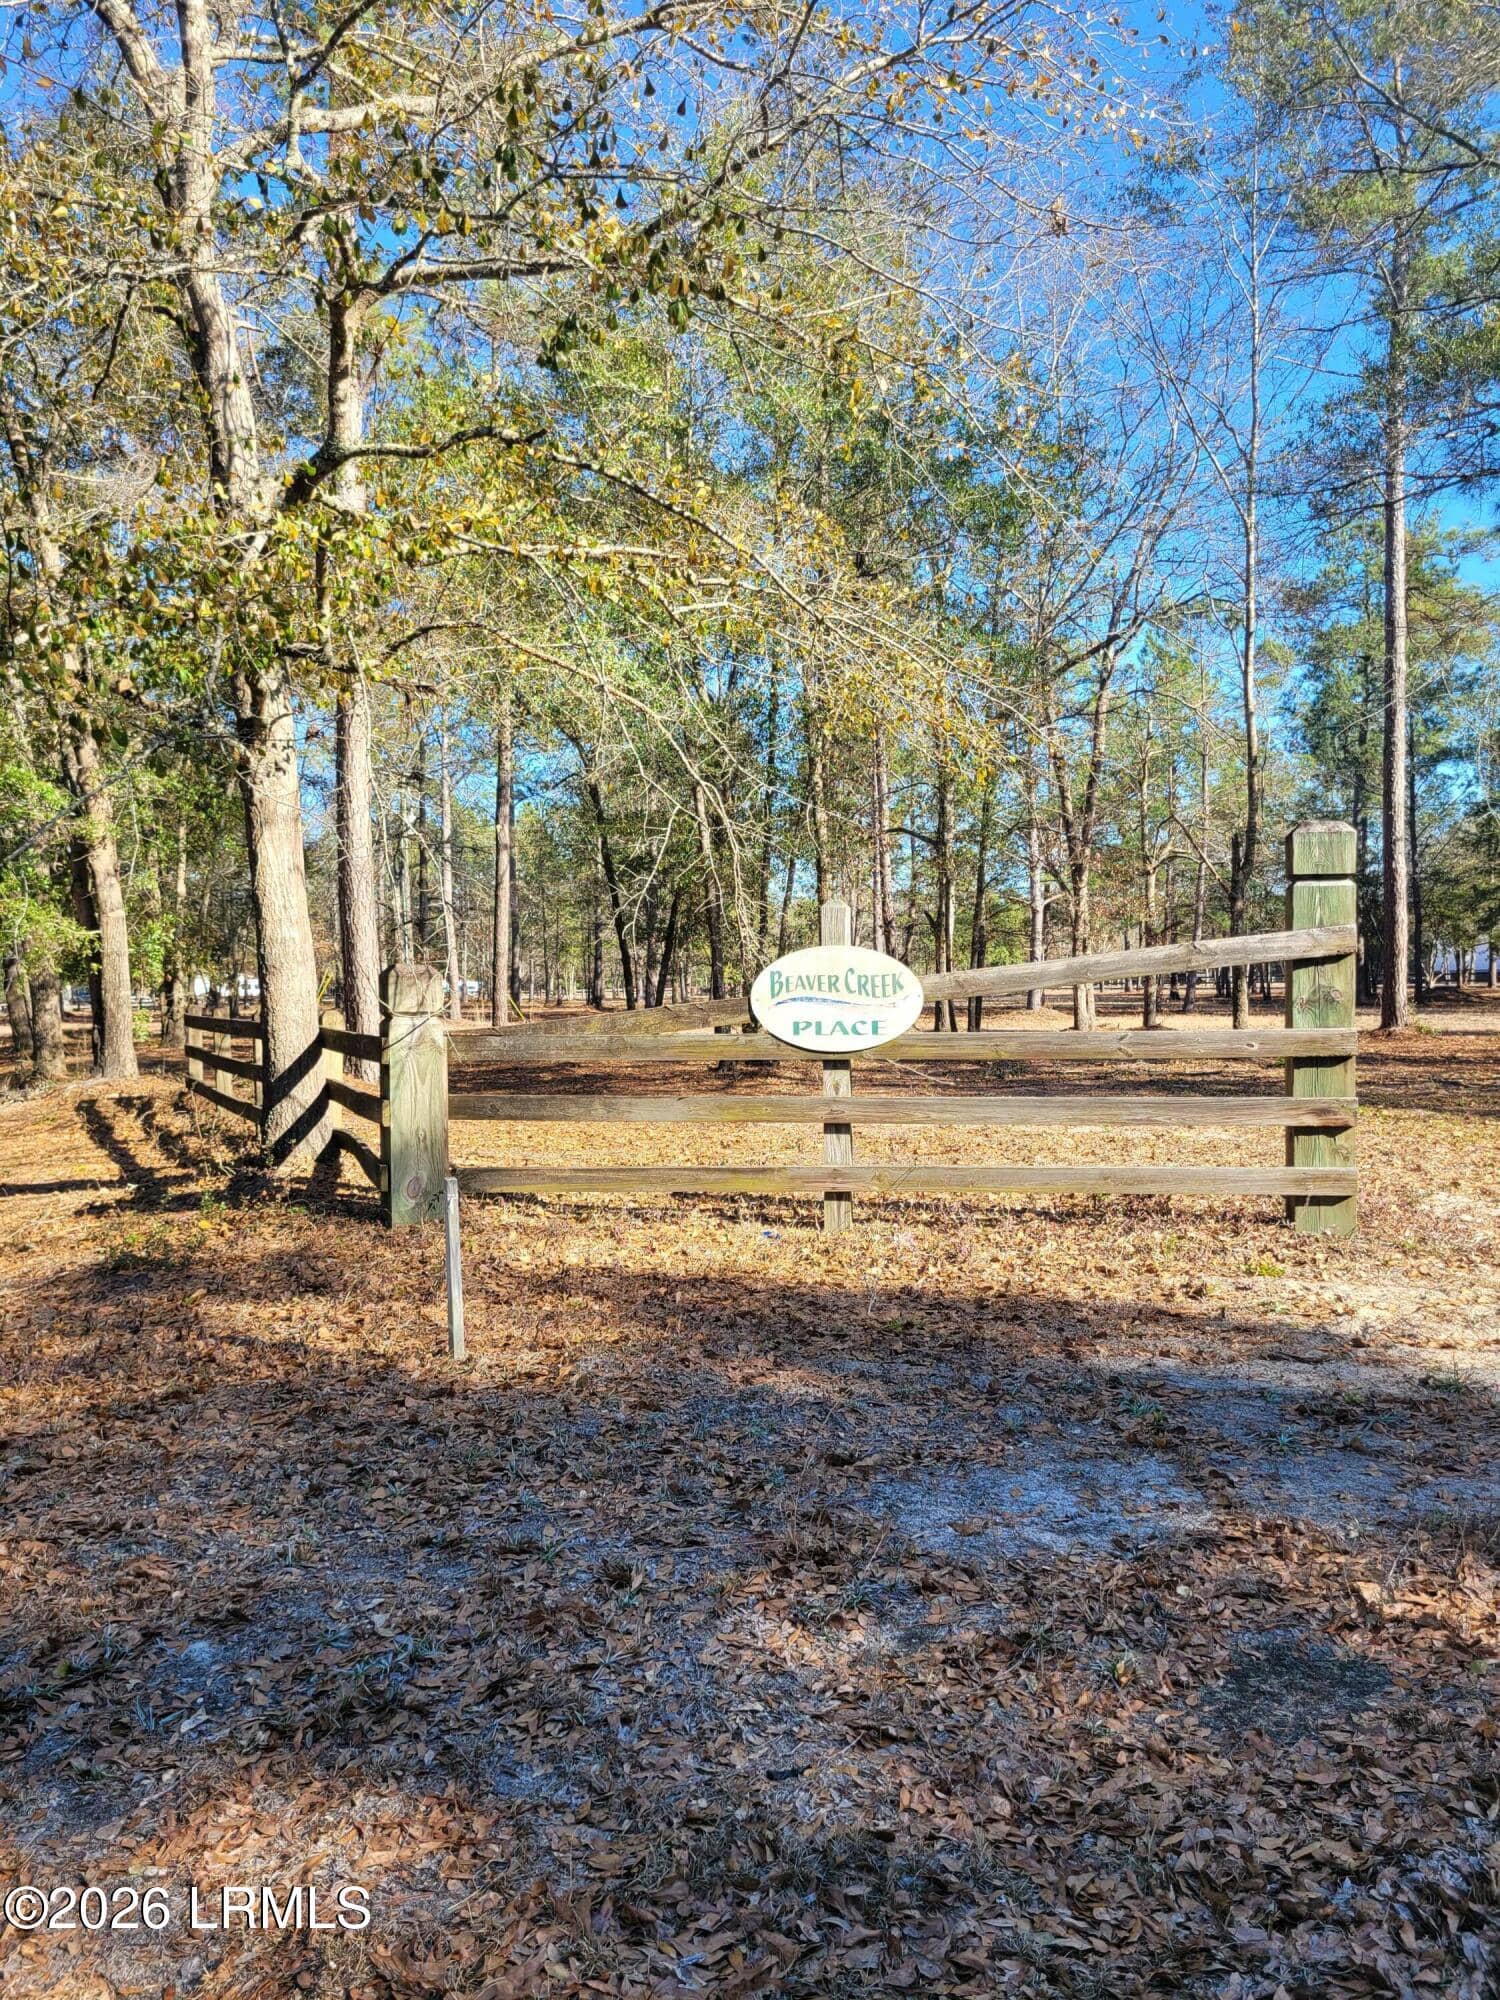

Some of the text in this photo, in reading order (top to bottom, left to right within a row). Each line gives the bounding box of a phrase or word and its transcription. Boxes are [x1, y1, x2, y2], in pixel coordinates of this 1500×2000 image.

[769, 967, 904, 999] BEAVER CREEK
[792, 1020, 888, 1036] PLACE
